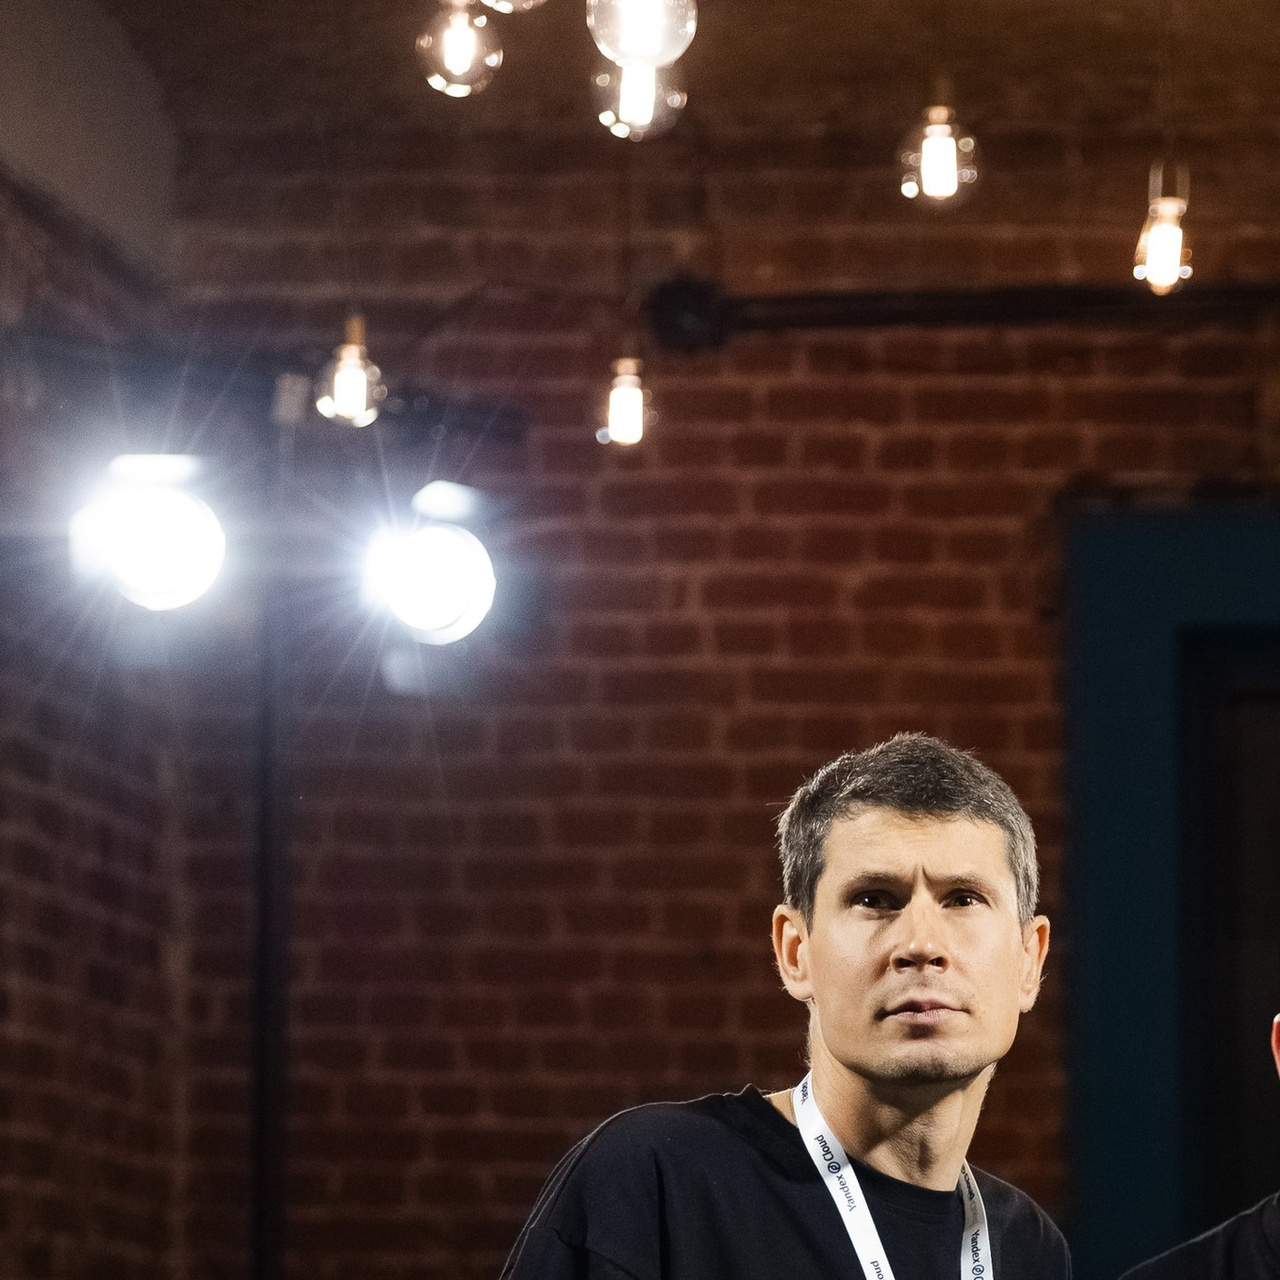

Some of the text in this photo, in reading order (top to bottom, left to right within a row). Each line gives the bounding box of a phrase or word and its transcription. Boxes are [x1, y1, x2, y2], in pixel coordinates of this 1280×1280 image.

[814, 1134, 857, 1212] Yandex Cloud
[971, 1229, 981, 1264] Yandex
